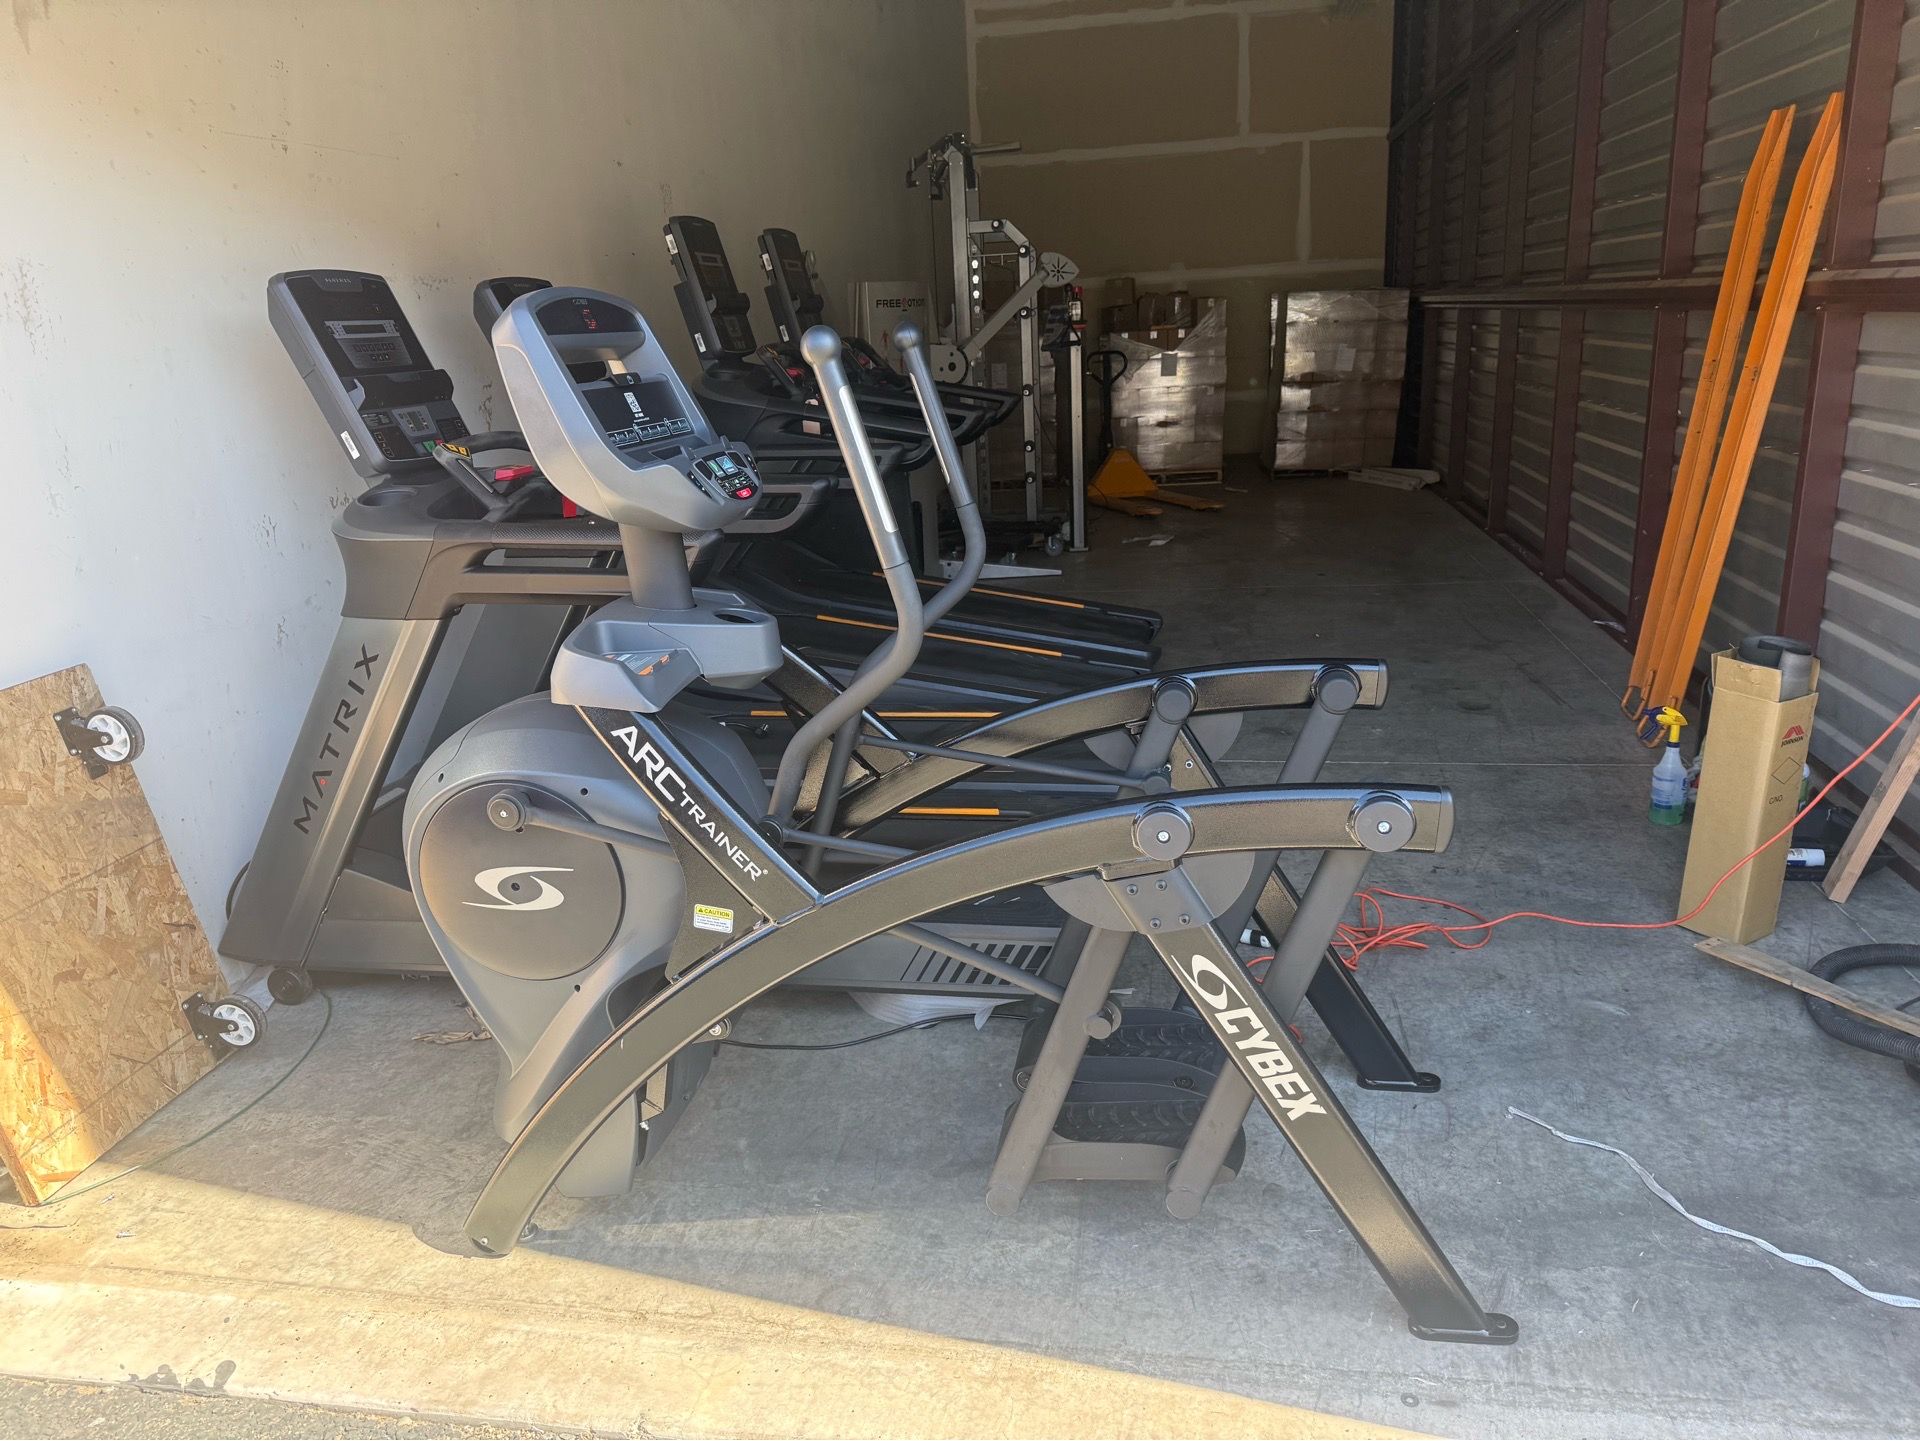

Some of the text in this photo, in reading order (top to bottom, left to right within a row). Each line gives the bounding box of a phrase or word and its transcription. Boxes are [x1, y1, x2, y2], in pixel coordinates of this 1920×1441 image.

[293, 643, 380, 835] MATRIX
[610, 725, 687, 802] ARC
[704, 908, 730, 917] CAUTION
[1214, 1006, 1328, 1121] CYBEX
